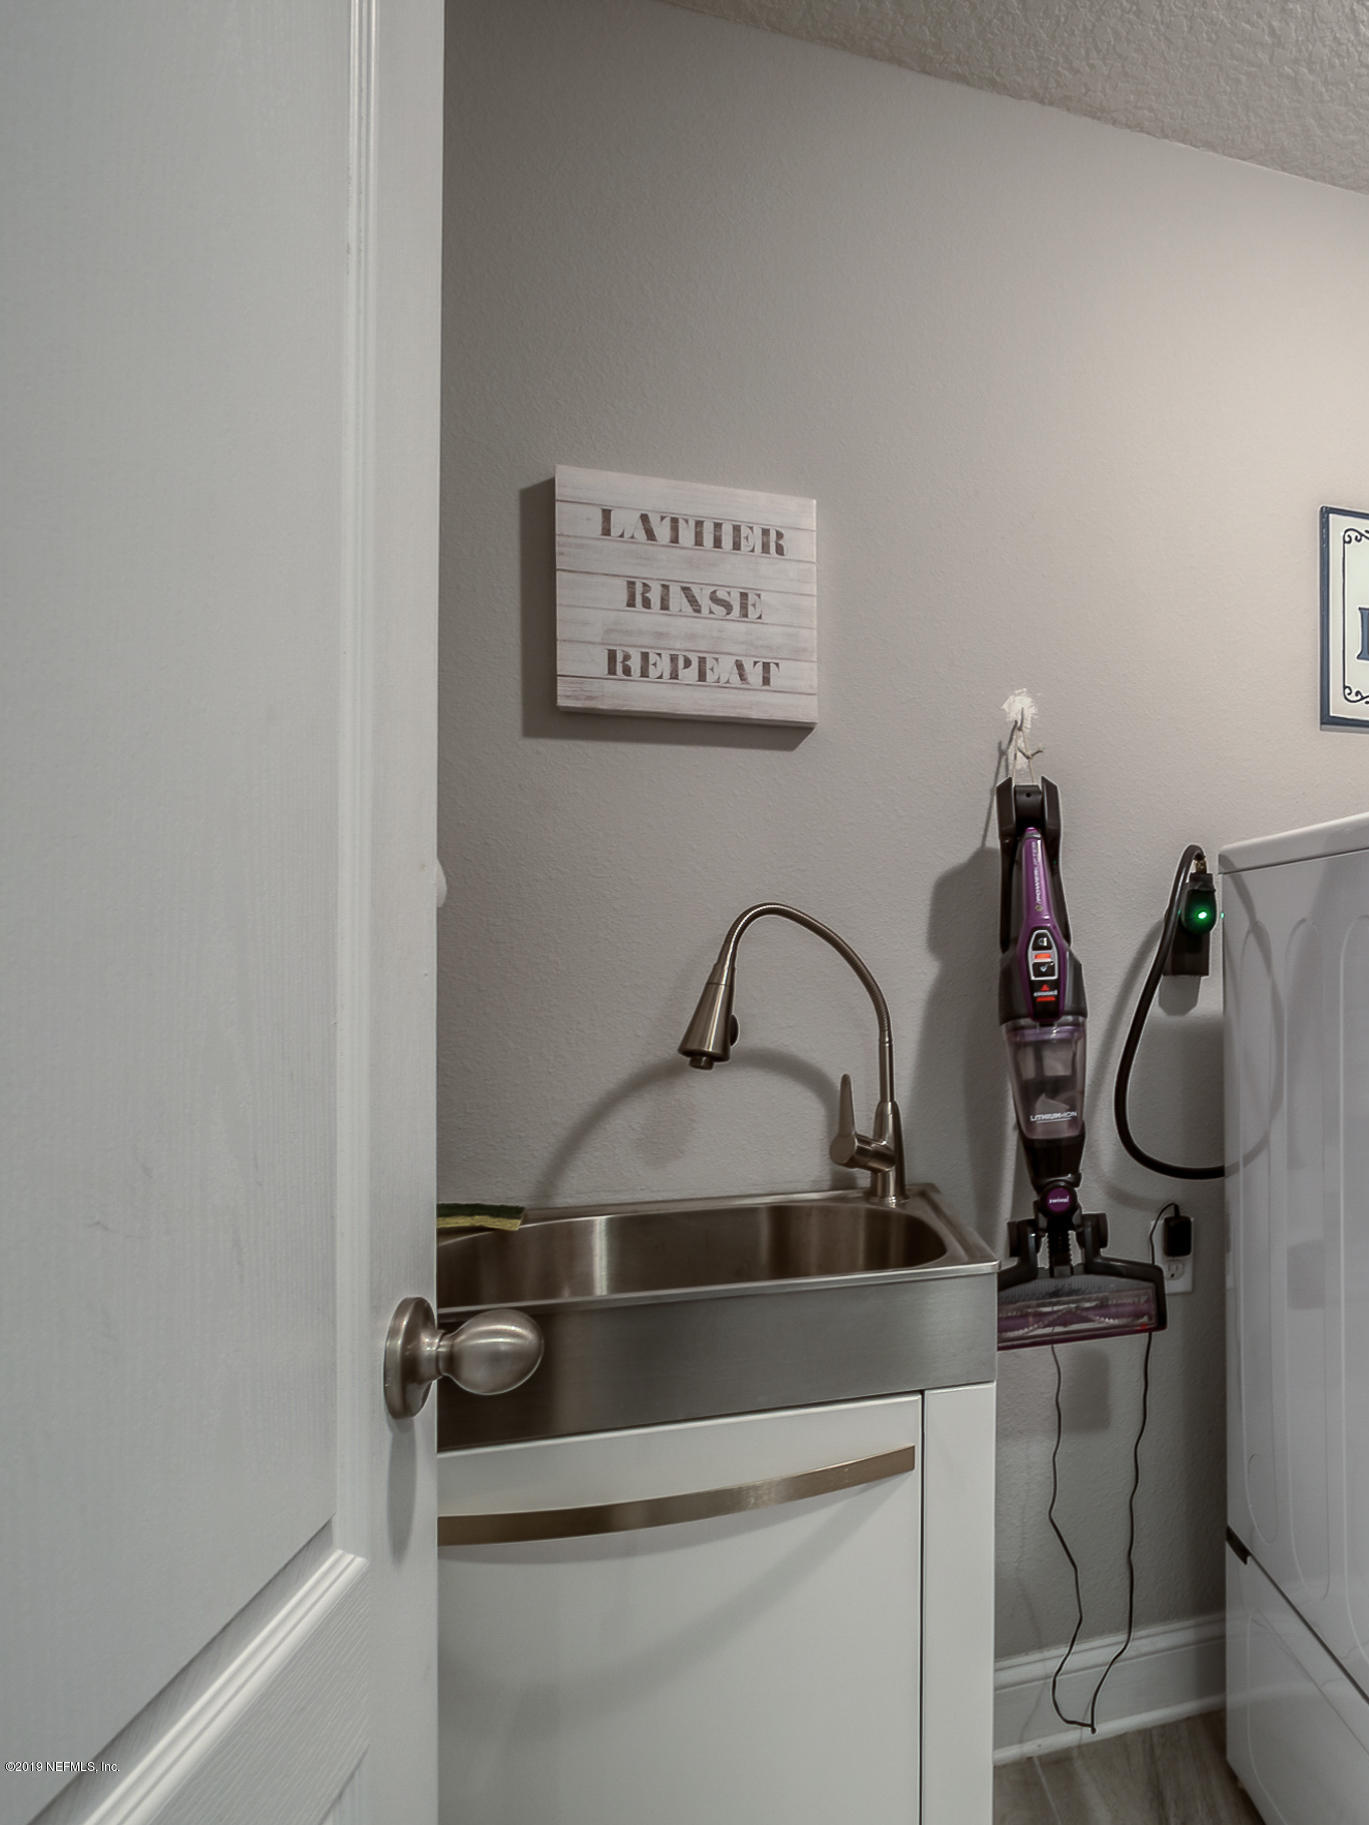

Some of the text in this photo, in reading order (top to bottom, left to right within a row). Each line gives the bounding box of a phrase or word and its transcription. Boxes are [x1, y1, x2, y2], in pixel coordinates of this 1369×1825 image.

[600, 508, 785, 556] LATHER
[625, 579, 763, 620] RINSE
[604, 648, 780, 688] REPEAT
